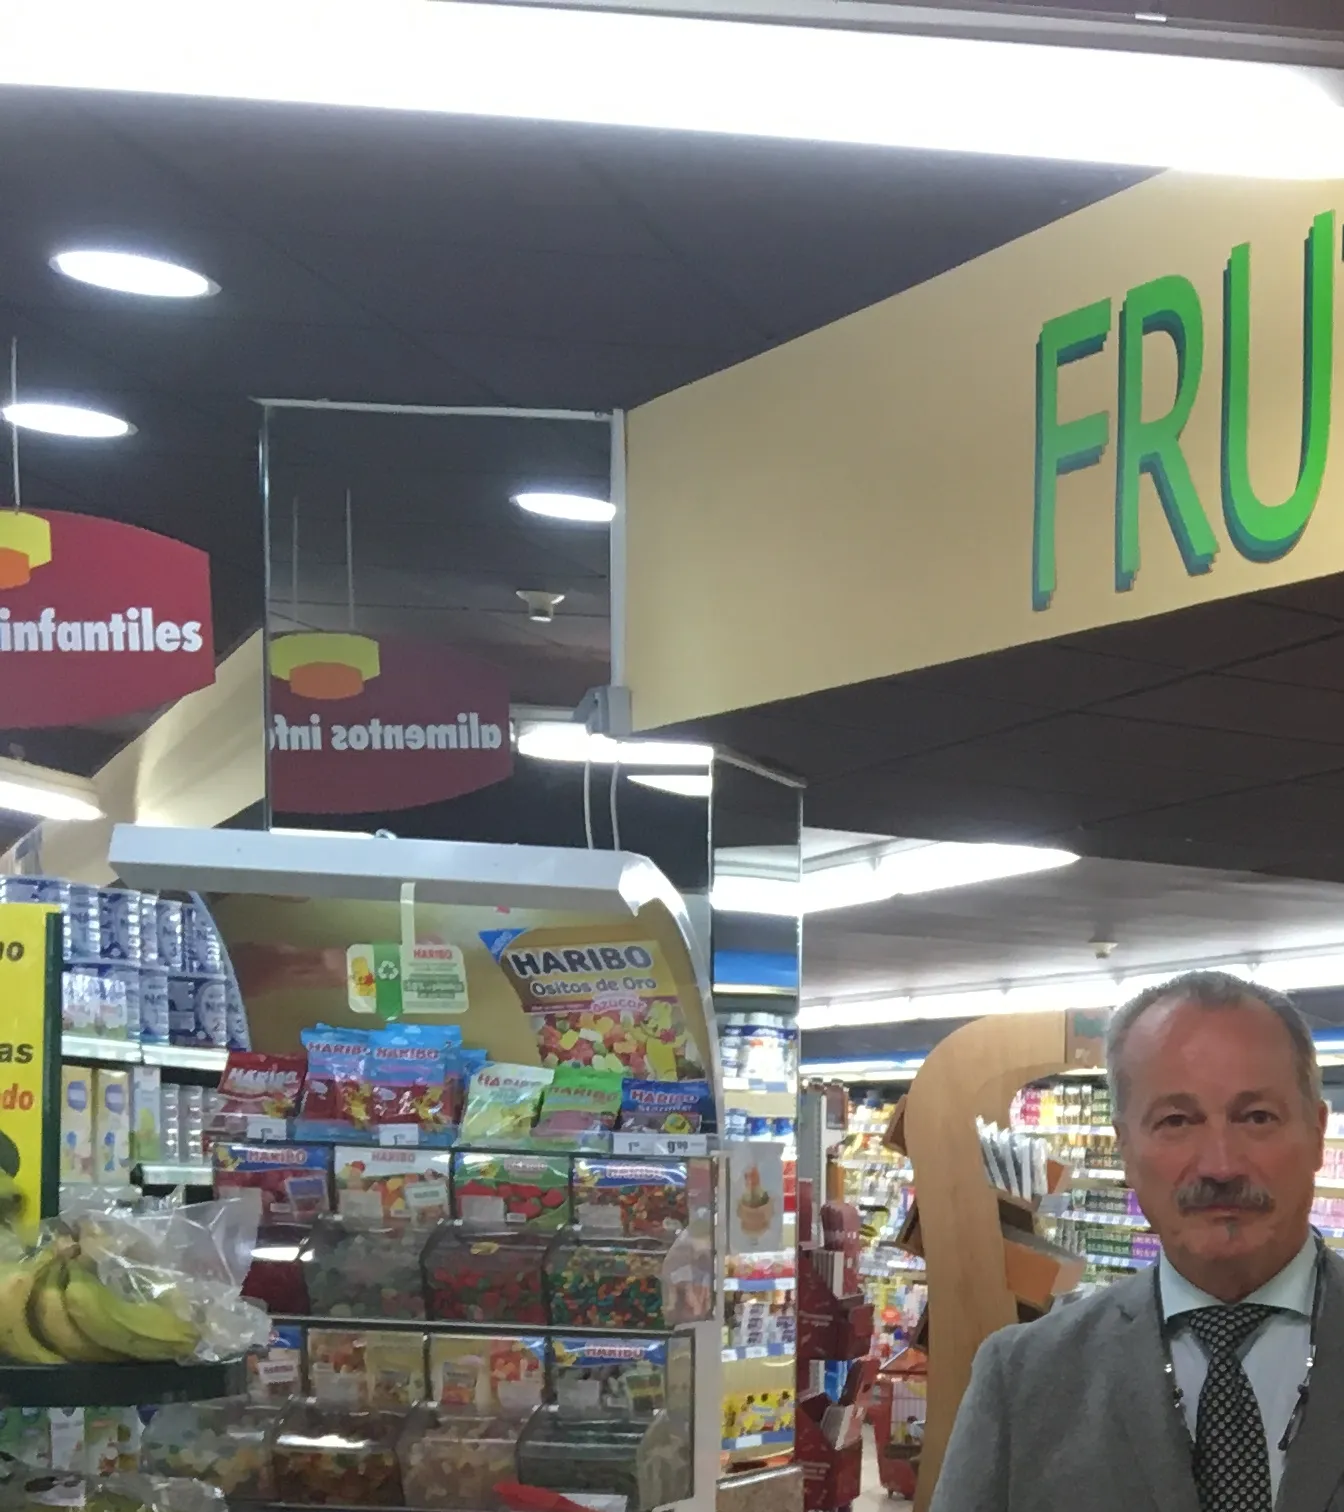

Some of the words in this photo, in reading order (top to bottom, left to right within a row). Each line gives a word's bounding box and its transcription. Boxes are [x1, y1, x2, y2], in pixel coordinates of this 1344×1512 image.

[0, 607, 204, 653] infantiles
[510, 945, 653, 976] HARIBO
[532, 980, 592, 997] Ositos
[595, 978, 619, 992] de
[622, 976, 657, 990] Oro
